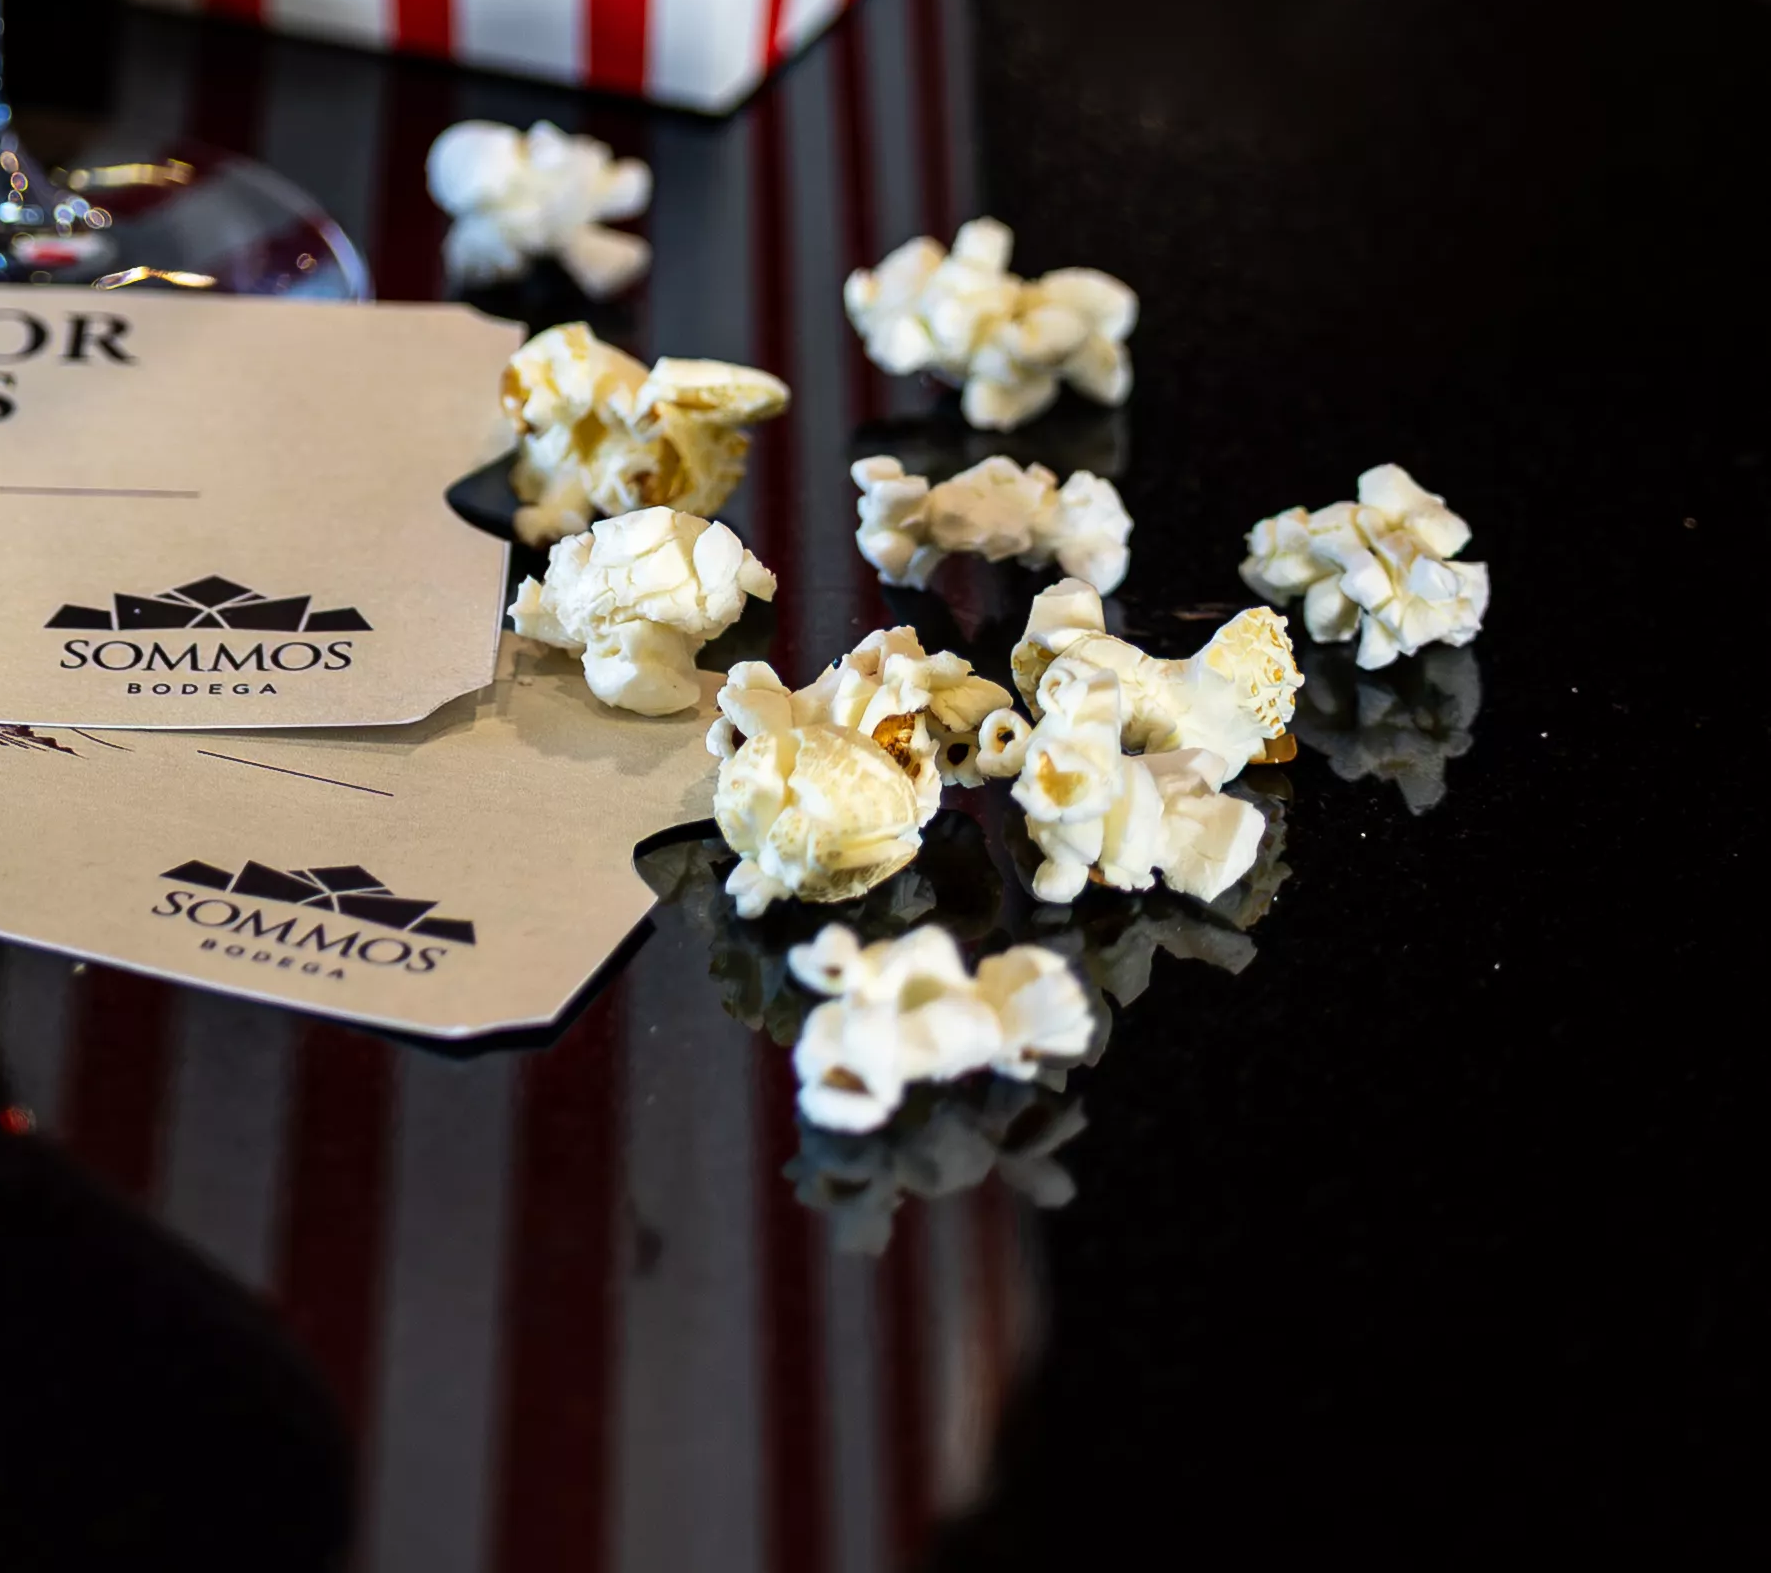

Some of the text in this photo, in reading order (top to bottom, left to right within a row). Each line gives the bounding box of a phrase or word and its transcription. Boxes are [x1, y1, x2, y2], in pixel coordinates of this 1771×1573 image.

[59, 639, 354, 674] SOMMOS
[127, 682, 278, 695] BODEGA
[151, 890, 448, 974] SOMMOS
[198, 937, 346, 981] BODEGA
